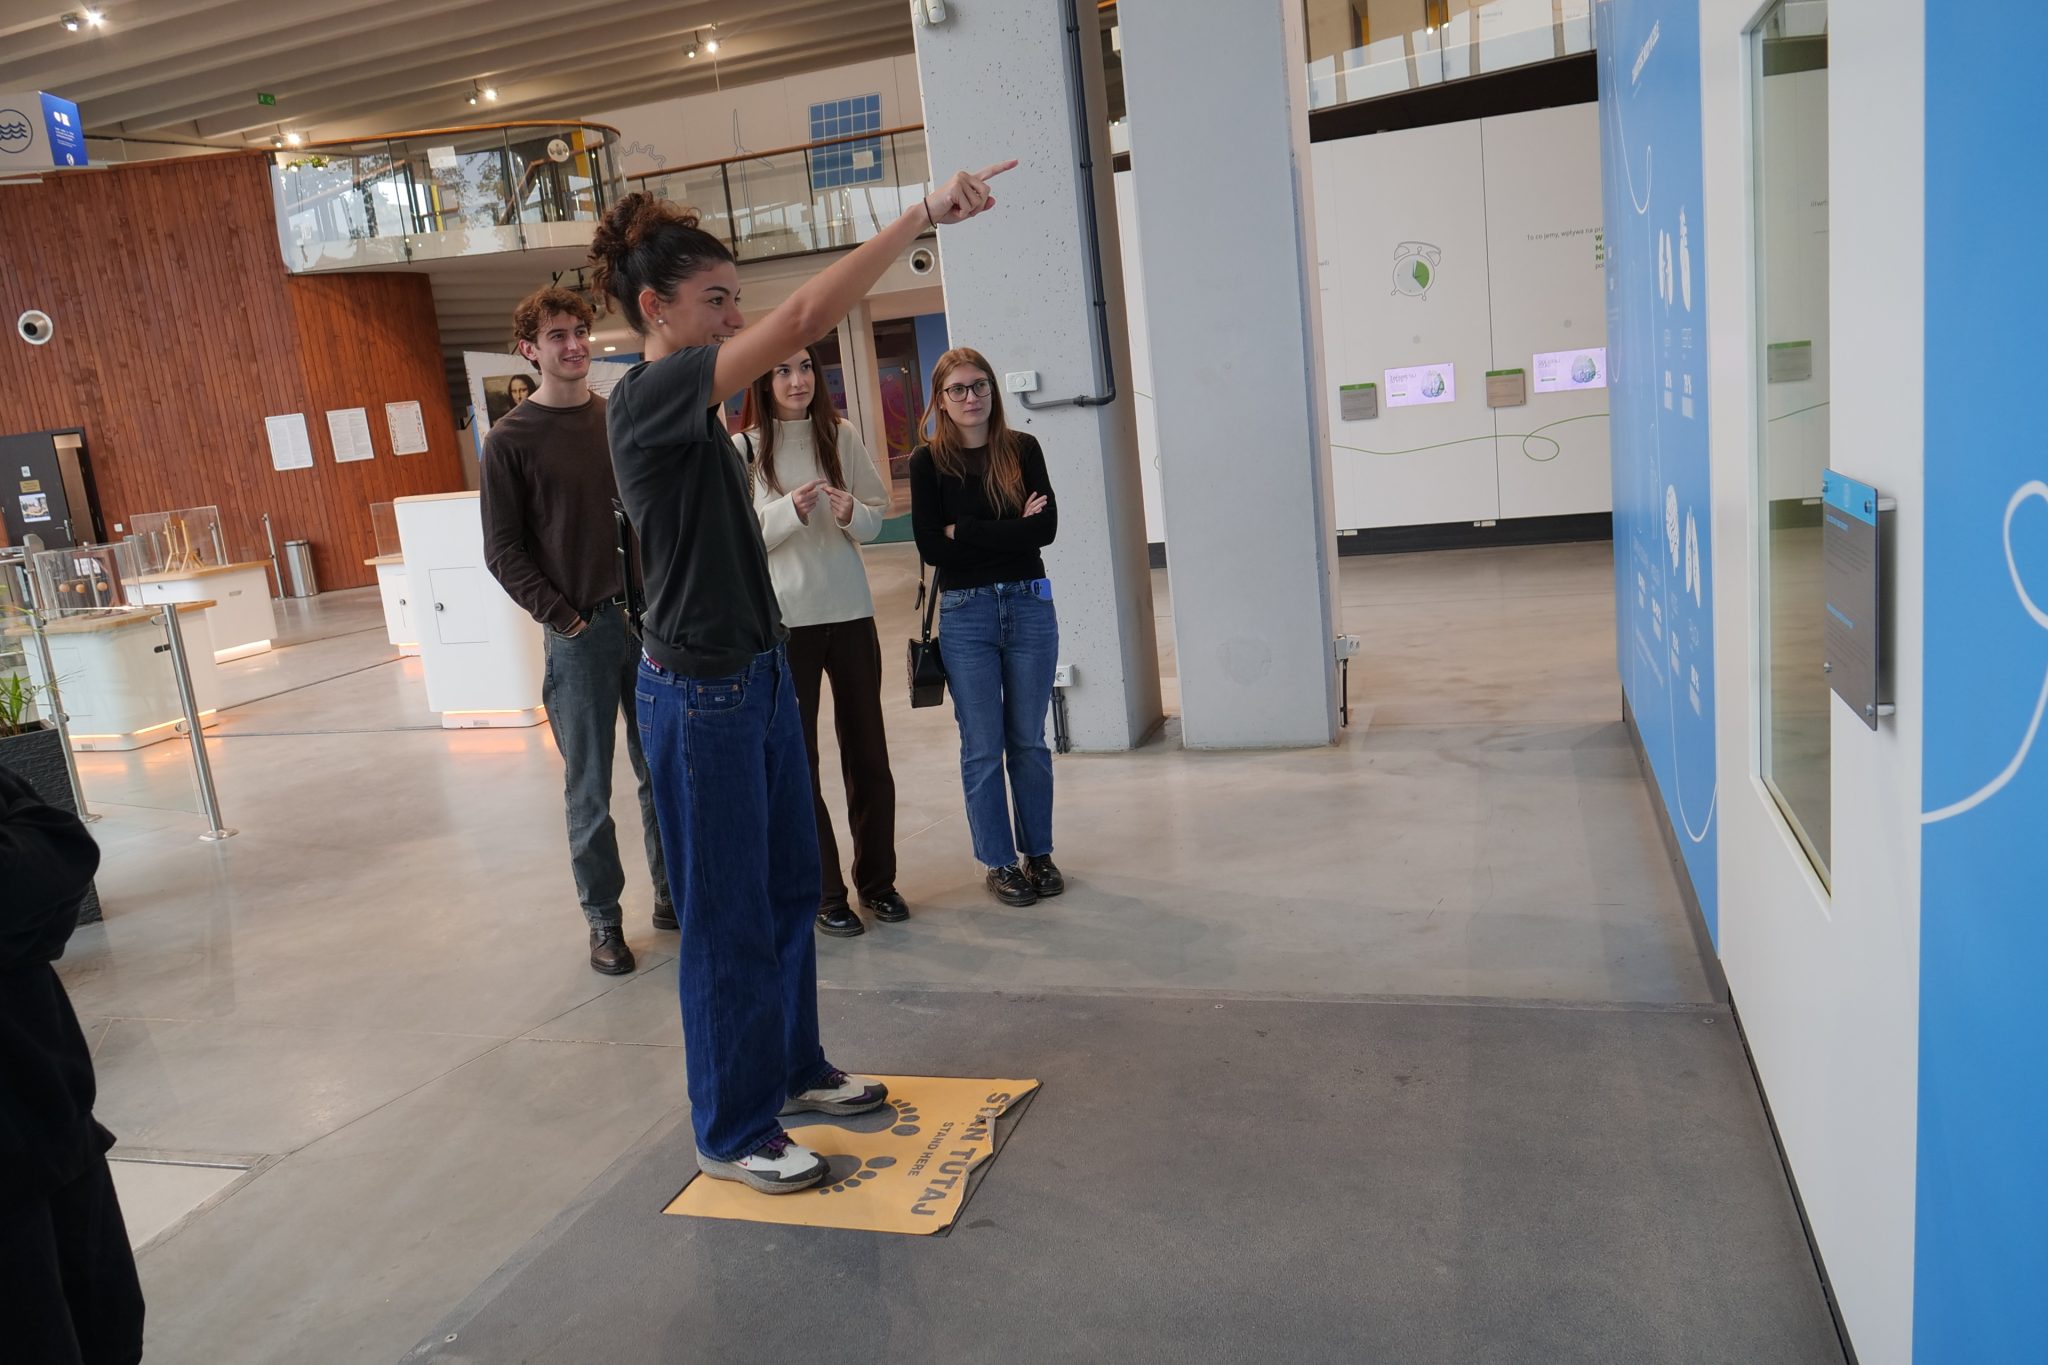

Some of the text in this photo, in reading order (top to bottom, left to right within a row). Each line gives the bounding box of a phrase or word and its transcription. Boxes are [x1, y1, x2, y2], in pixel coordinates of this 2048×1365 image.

[907, 1121, 954, 1177] STAND HERE
[911, 1148, 977, 1216] TUTAJ
